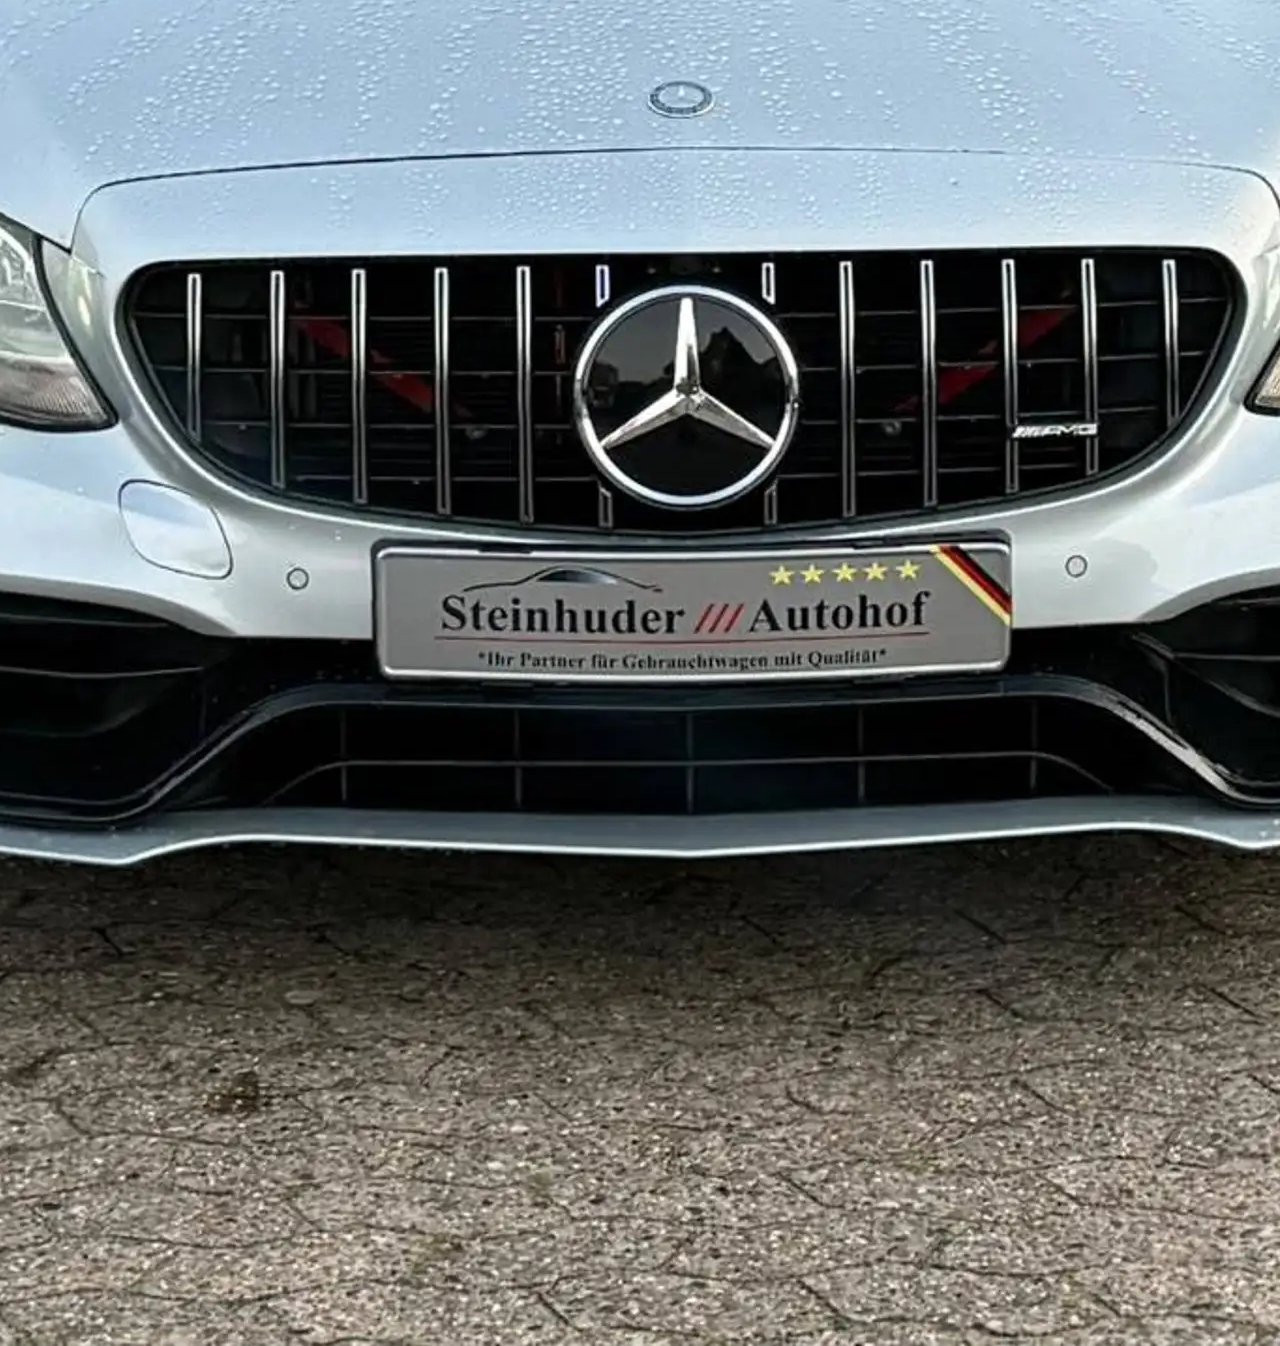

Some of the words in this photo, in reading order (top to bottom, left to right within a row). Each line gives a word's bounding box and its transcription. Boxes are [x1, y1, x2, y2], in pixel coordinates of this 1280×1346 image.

[441, 594, 686, 634] Steinhuder
[749, 590, 931, 633] Autohof
[520, 651, 587, 669] Partner
[591, 653, 619, 670] für
[622, 653, 768, 672] Gebrauchtwagen
[774, 651, 803, 667] mit
